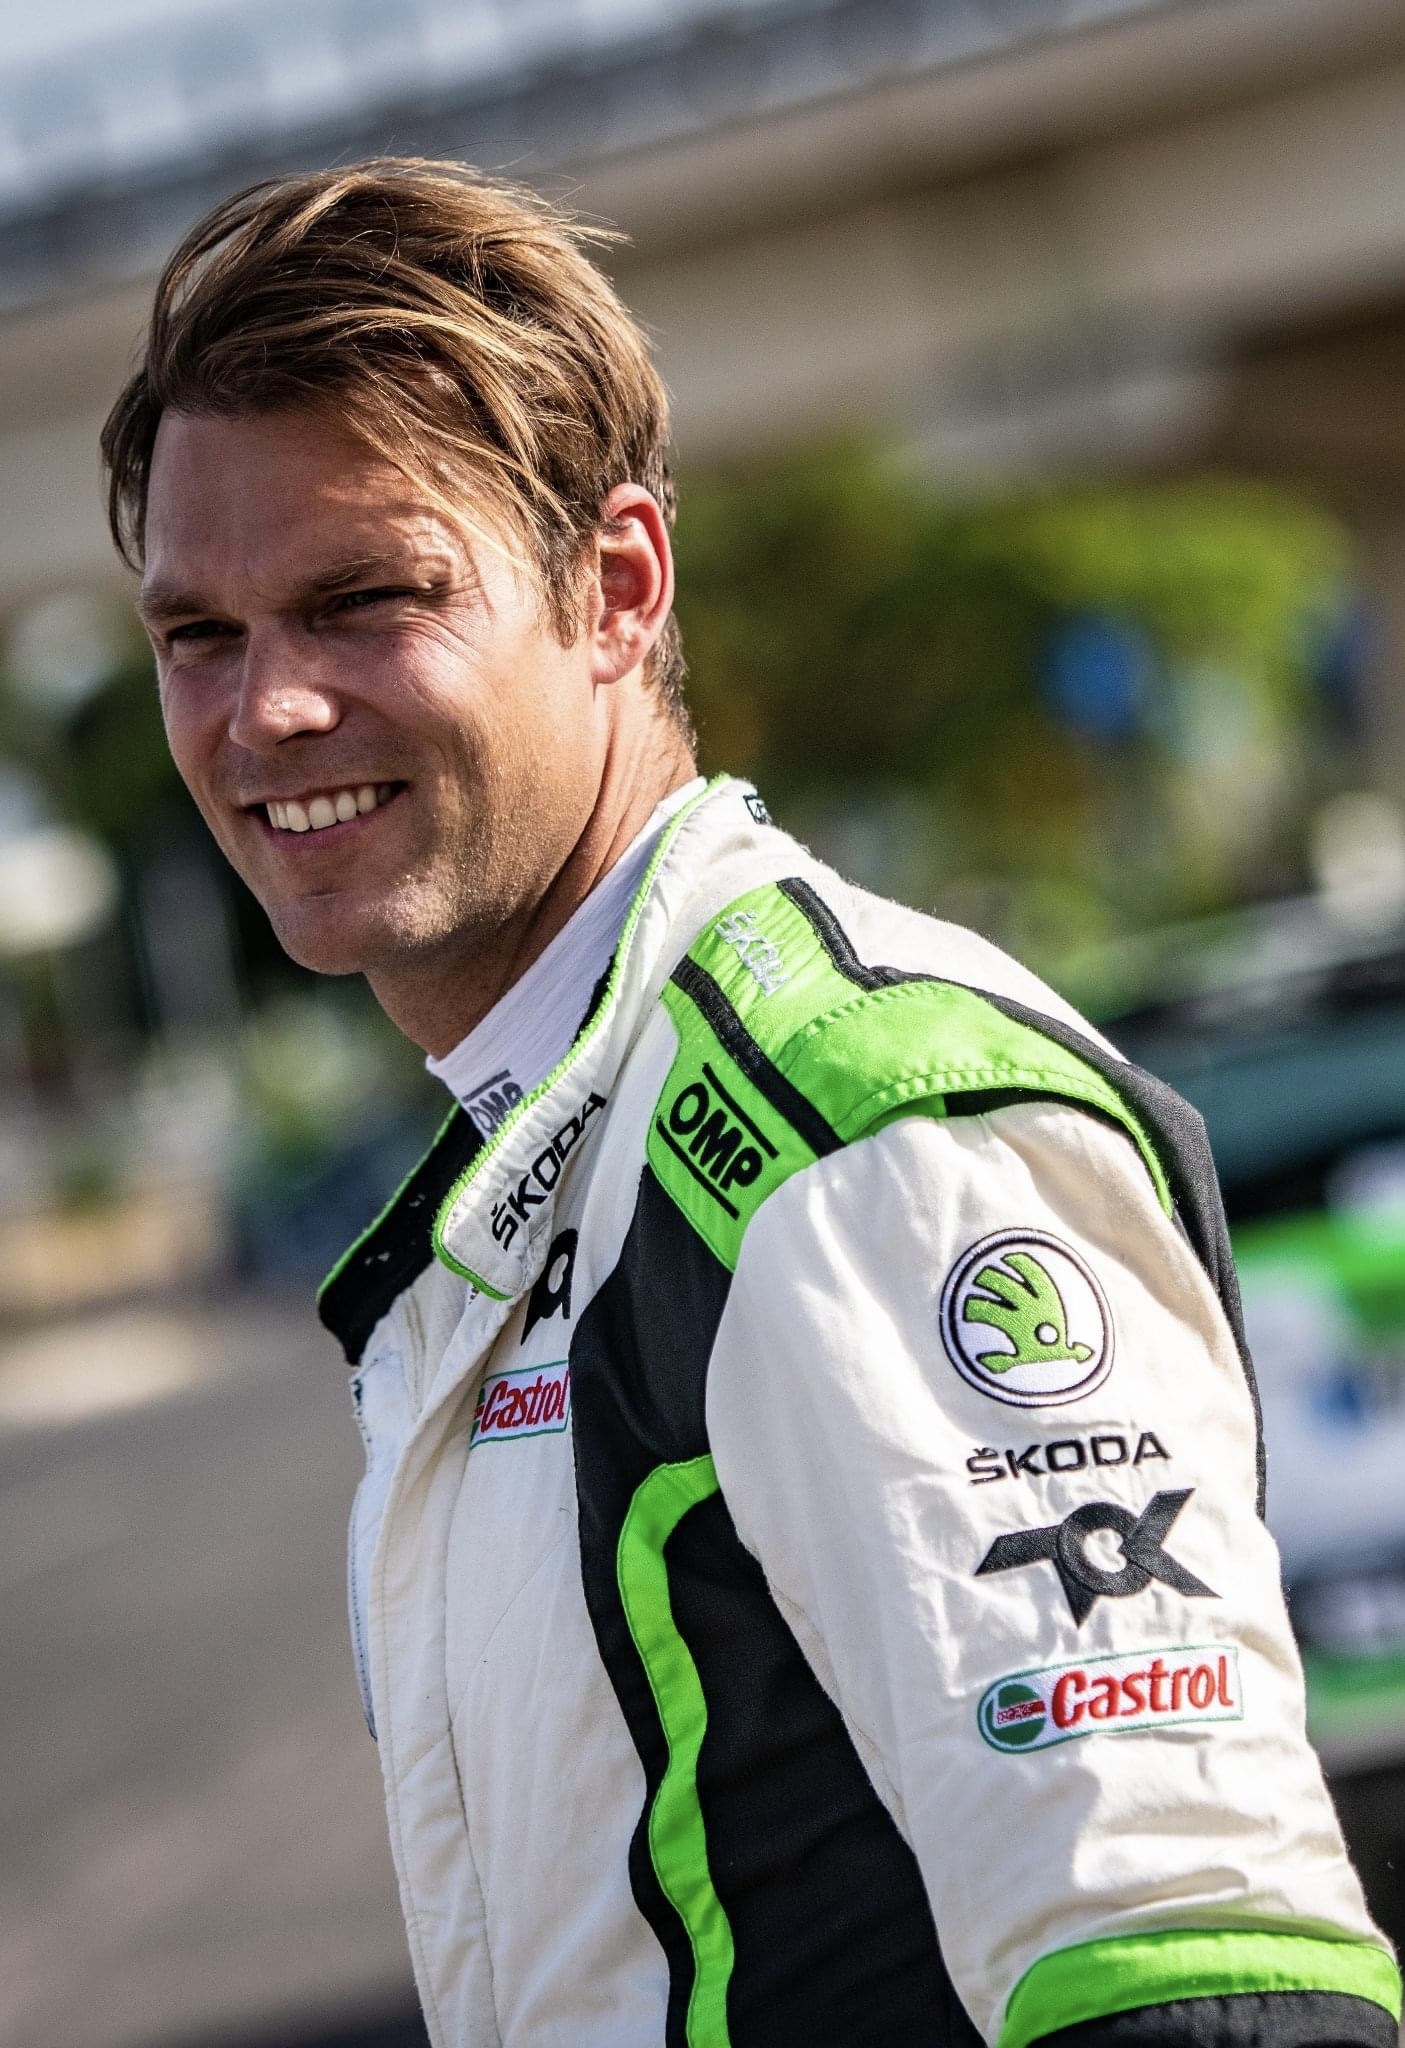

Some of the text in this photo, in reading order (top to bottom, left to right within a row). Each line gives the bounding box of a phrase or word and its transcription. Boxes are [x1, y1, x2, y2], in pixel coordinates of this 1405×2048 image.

[491, 1091, 607, 1252] ŠKODA
[669, 1081, 763, 1191] OMP
[480, 1370, 570, 1434] Castrol
[965, 1432, 1172, 1486] ŠKODA
[1051, 1655, 1234, 1729] Castrol
